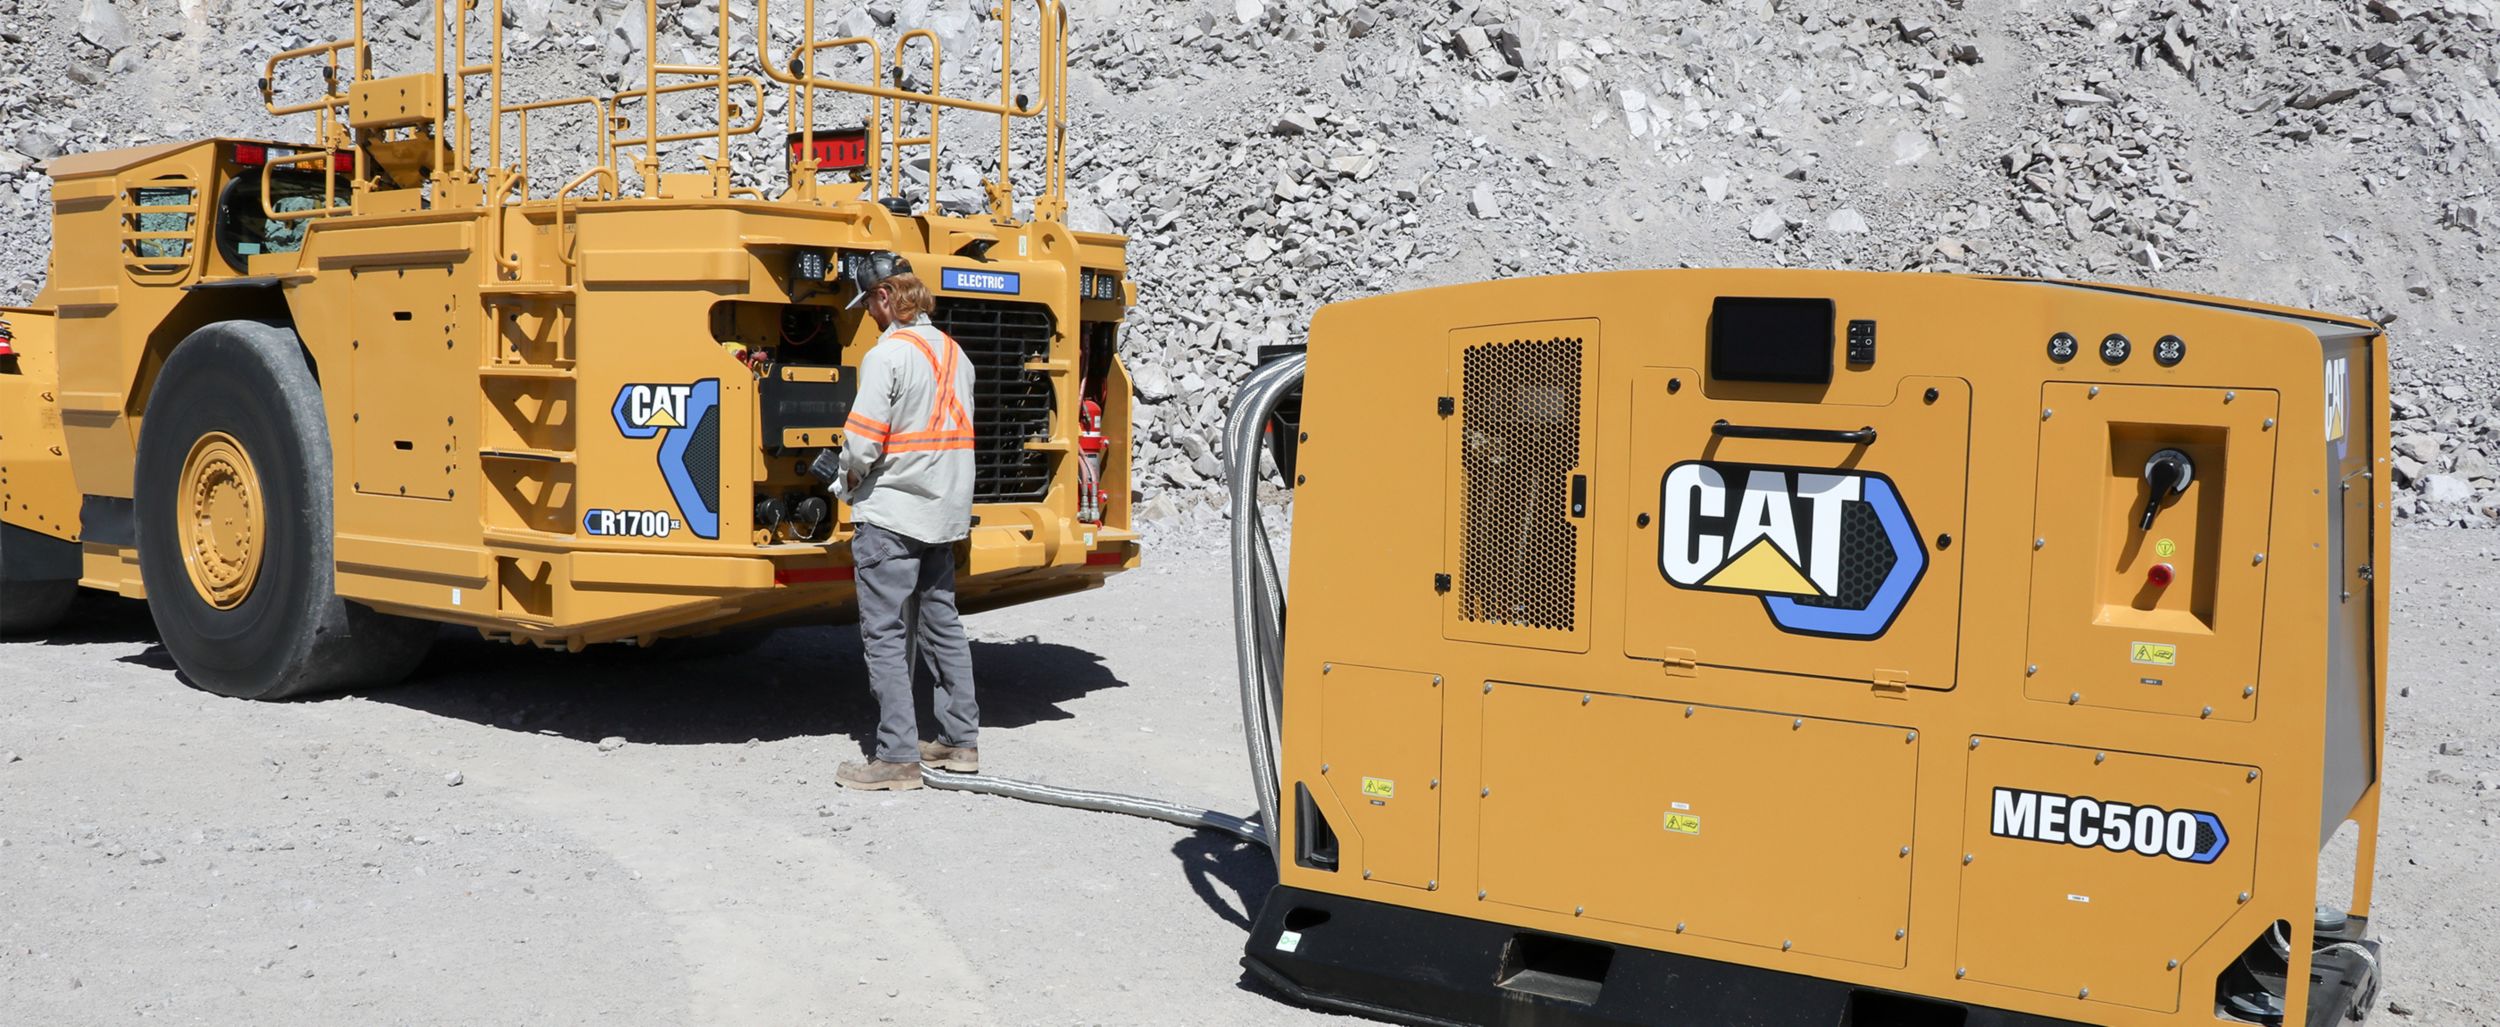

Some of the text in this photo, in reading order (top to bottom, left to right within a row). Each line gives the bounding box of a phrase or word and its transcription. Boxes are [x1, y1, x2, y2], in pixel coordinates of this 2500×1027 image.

[957, 273, 1005, 289] ELECTRIC
[631, 385, 690, 427] CAT
[2325, 357, 2346, 442] CAT
[1662, 463, 1861, 597] CAT
[1993, 789, 2198, 860] MEC500
